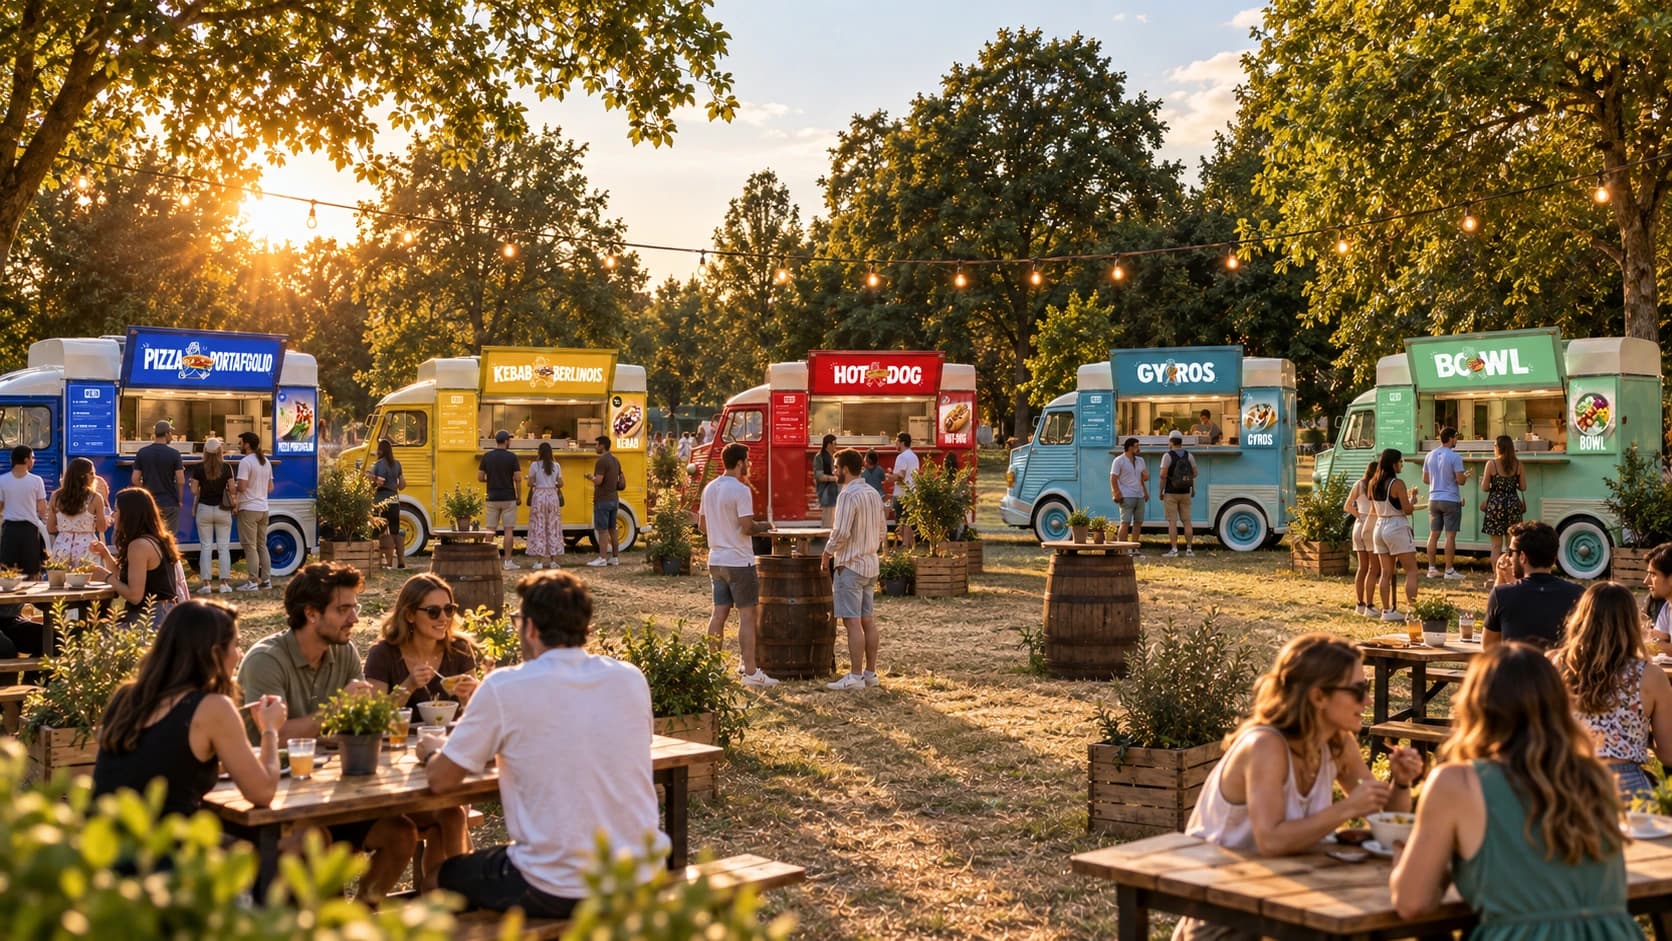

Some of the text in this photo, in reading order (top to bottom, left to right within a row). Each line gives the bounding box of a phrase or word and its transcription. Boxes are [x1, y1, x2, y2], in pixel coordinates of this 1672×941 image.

[144, 348, 183, 370] PIZZA
[494, 365, 603, 383] KEBAB BERLINOIS
[834, 365, 922, 384] HOT DOG
[1137, 362, 1216, 383] GYROS
[1248, 433, 1273, 445] GYROS
[1580, 435, 1606, 450] BOWL
